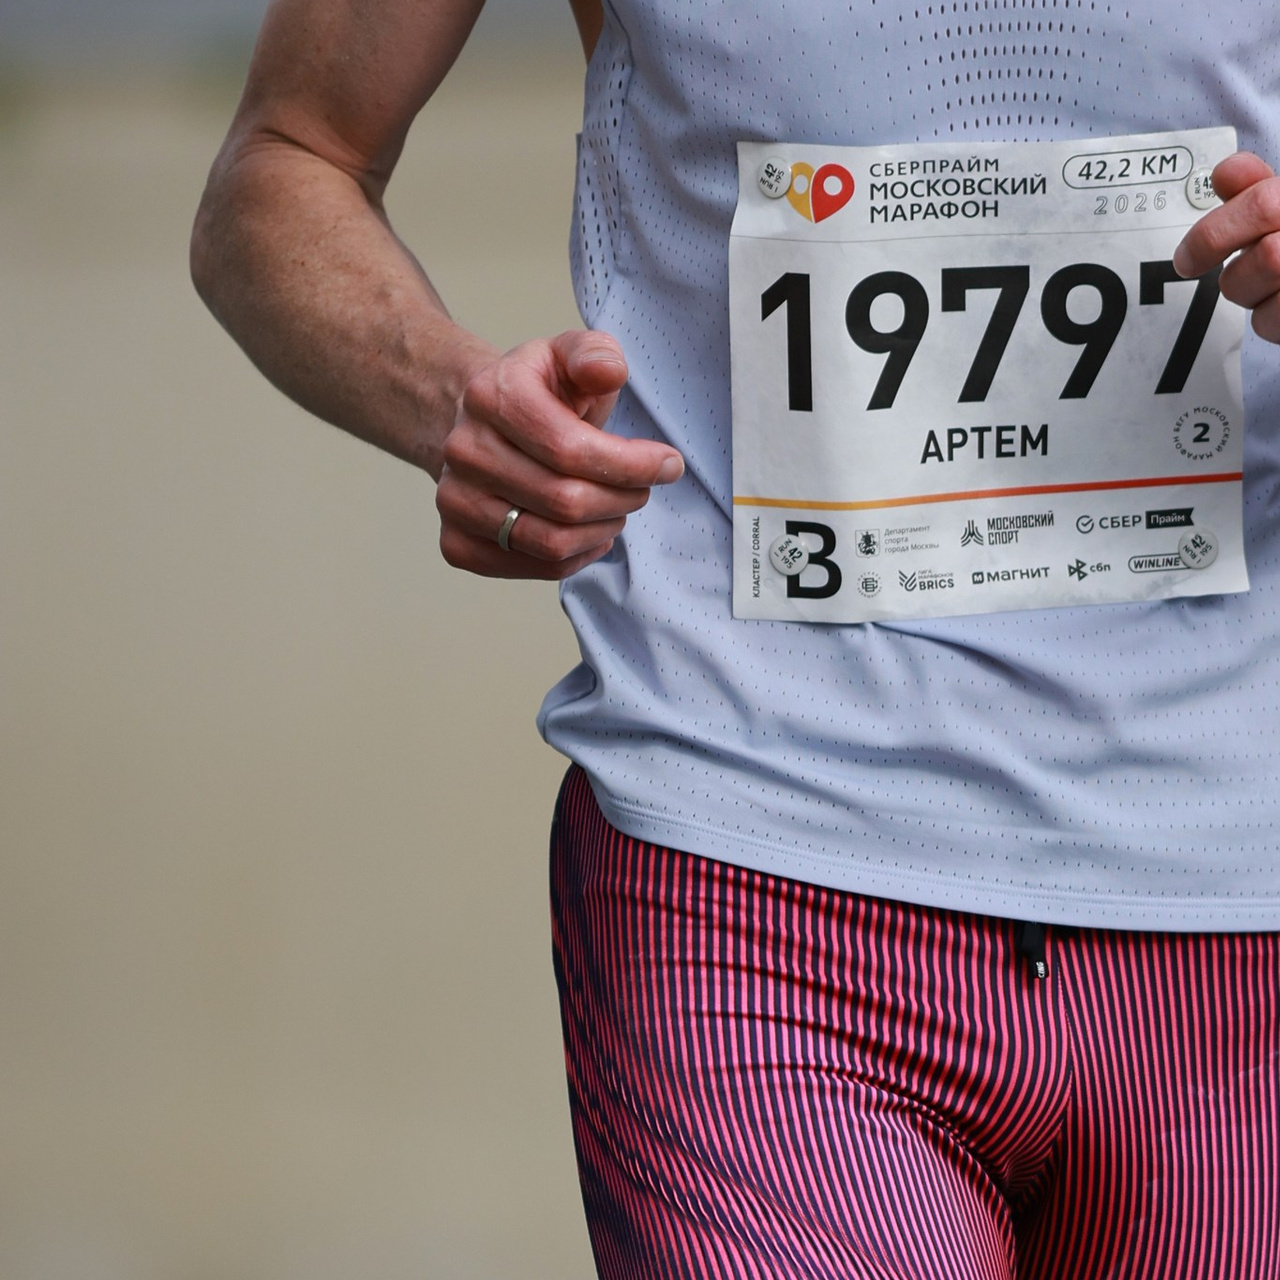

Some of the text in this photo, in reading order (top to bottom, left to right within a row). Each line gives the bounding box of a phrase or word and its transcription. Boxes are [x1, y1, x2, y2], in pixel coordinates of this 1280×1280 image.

[764, 162, 778, 179] 42
[869, 155, 1000, 178] СБЕРПРАЙМ
[1078, 158, 1131, 182] 42,2
[759, 176, 774, 190] RUN
[773, 169, 785, 184] 195
[869, 173, 1048, 202] МОСКОВСКИЙ
[1093, 190, 1167, 215] 2026
[869, 199, 1000, 224] МАРАФОН
[760, 260, 1223, 412] 19797
[1192, 422, 1210, 443] 2
[919, 423, 1049, 464] АРТЕМ
[987, 510, 1055, 531] МОСКОВСКИЙ
[1099, 513, 1186, 530] СБЕР Прайм
[752, 516, 760, 550] CORRAL
[884, 525, 930, 537] Департамент
[988, 530, 1019, 546] СПОРТ
[778, 538, 792, 554] RUN
[1191, 532, 1206, 549] 42
[788, 547, 803, 563] 42
[1182, 544, 1198, 560] RUN
[1200, 543, 1212, 556] 195
[781, 555, 794, 570] 195
[1089, 562, 1111, 573] сбп
[1133, 557, 1181, 570] WINLINE
[752, 557, 760, 598] КЛАСТЕР
[918, 578, 955, 591] BRICS
